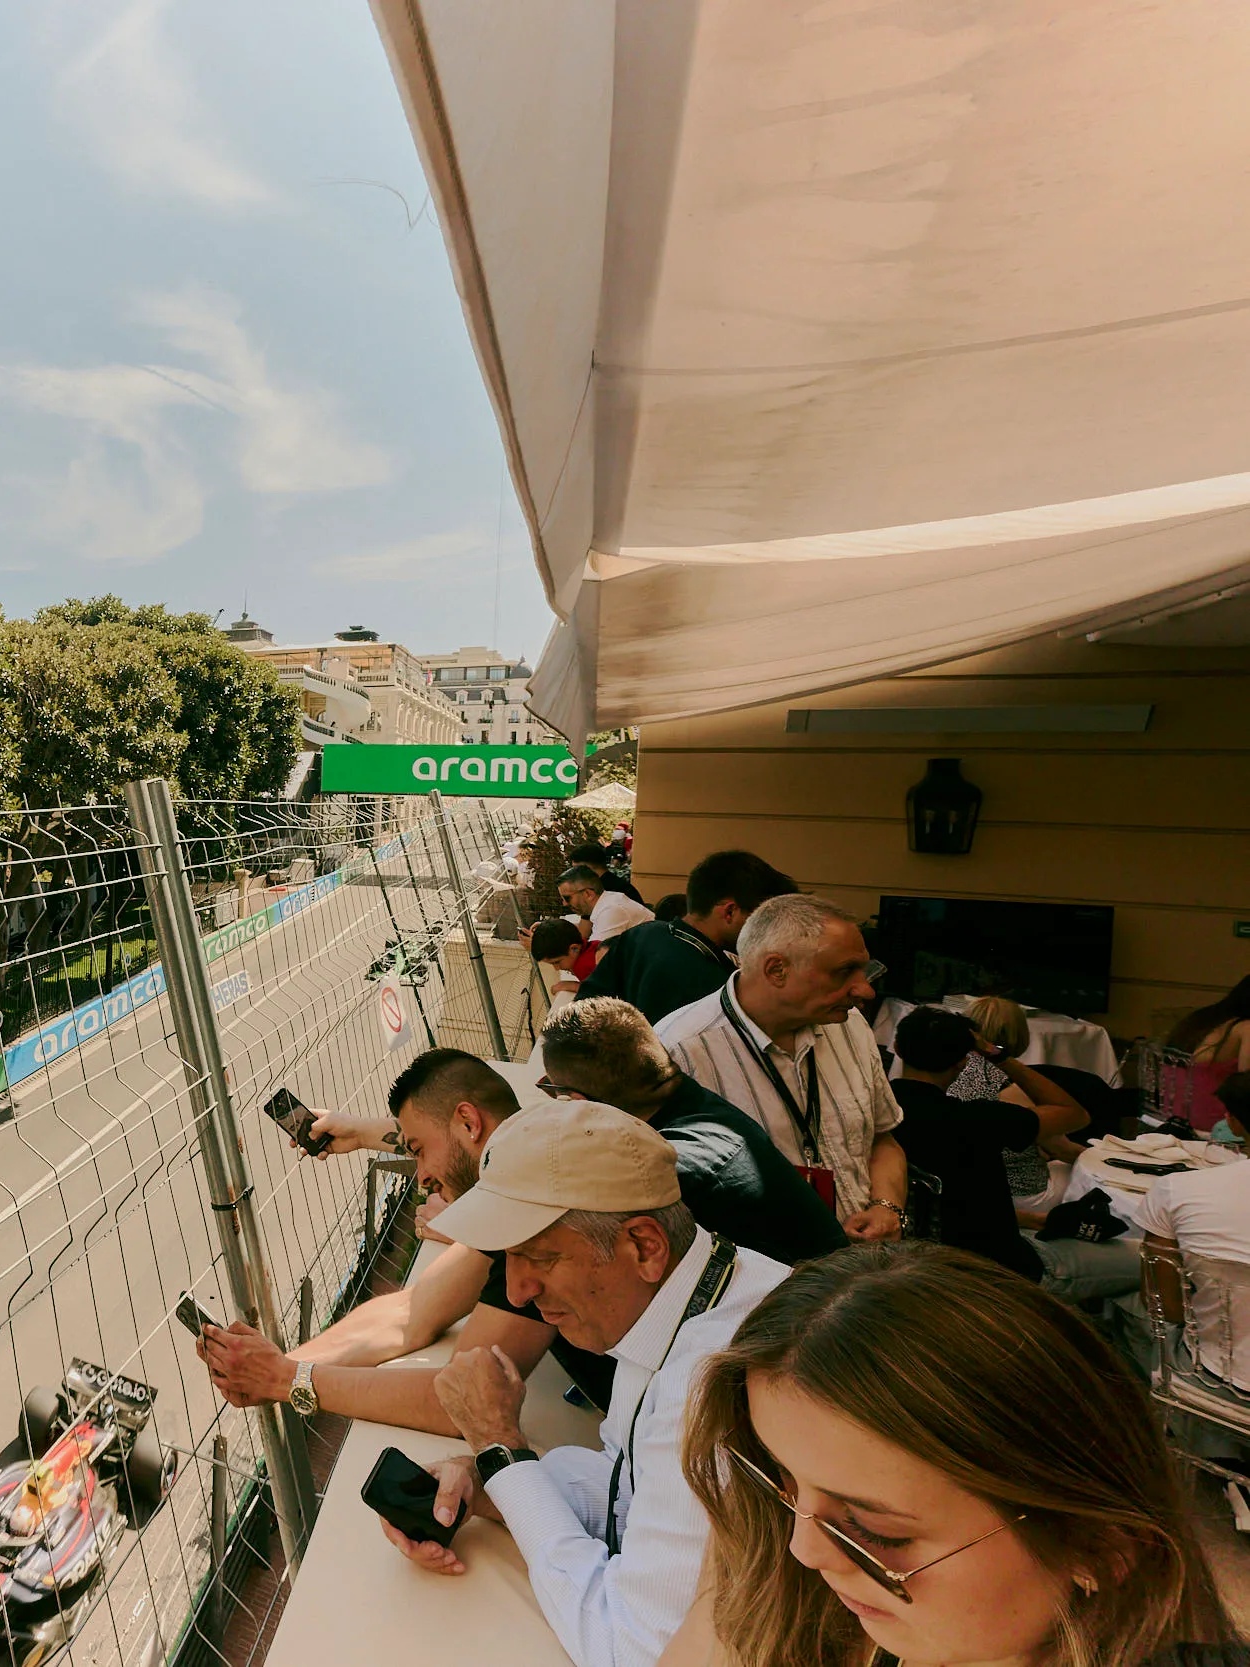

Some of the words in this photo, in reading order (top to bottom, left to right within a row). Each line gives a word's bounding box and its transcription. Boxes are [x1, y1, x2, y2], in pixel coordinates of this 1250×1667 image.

[412, 757, 579, 784] aramco
[206, 915, 267, 962] ramco
[34, 974, 162, 1062] aramco
